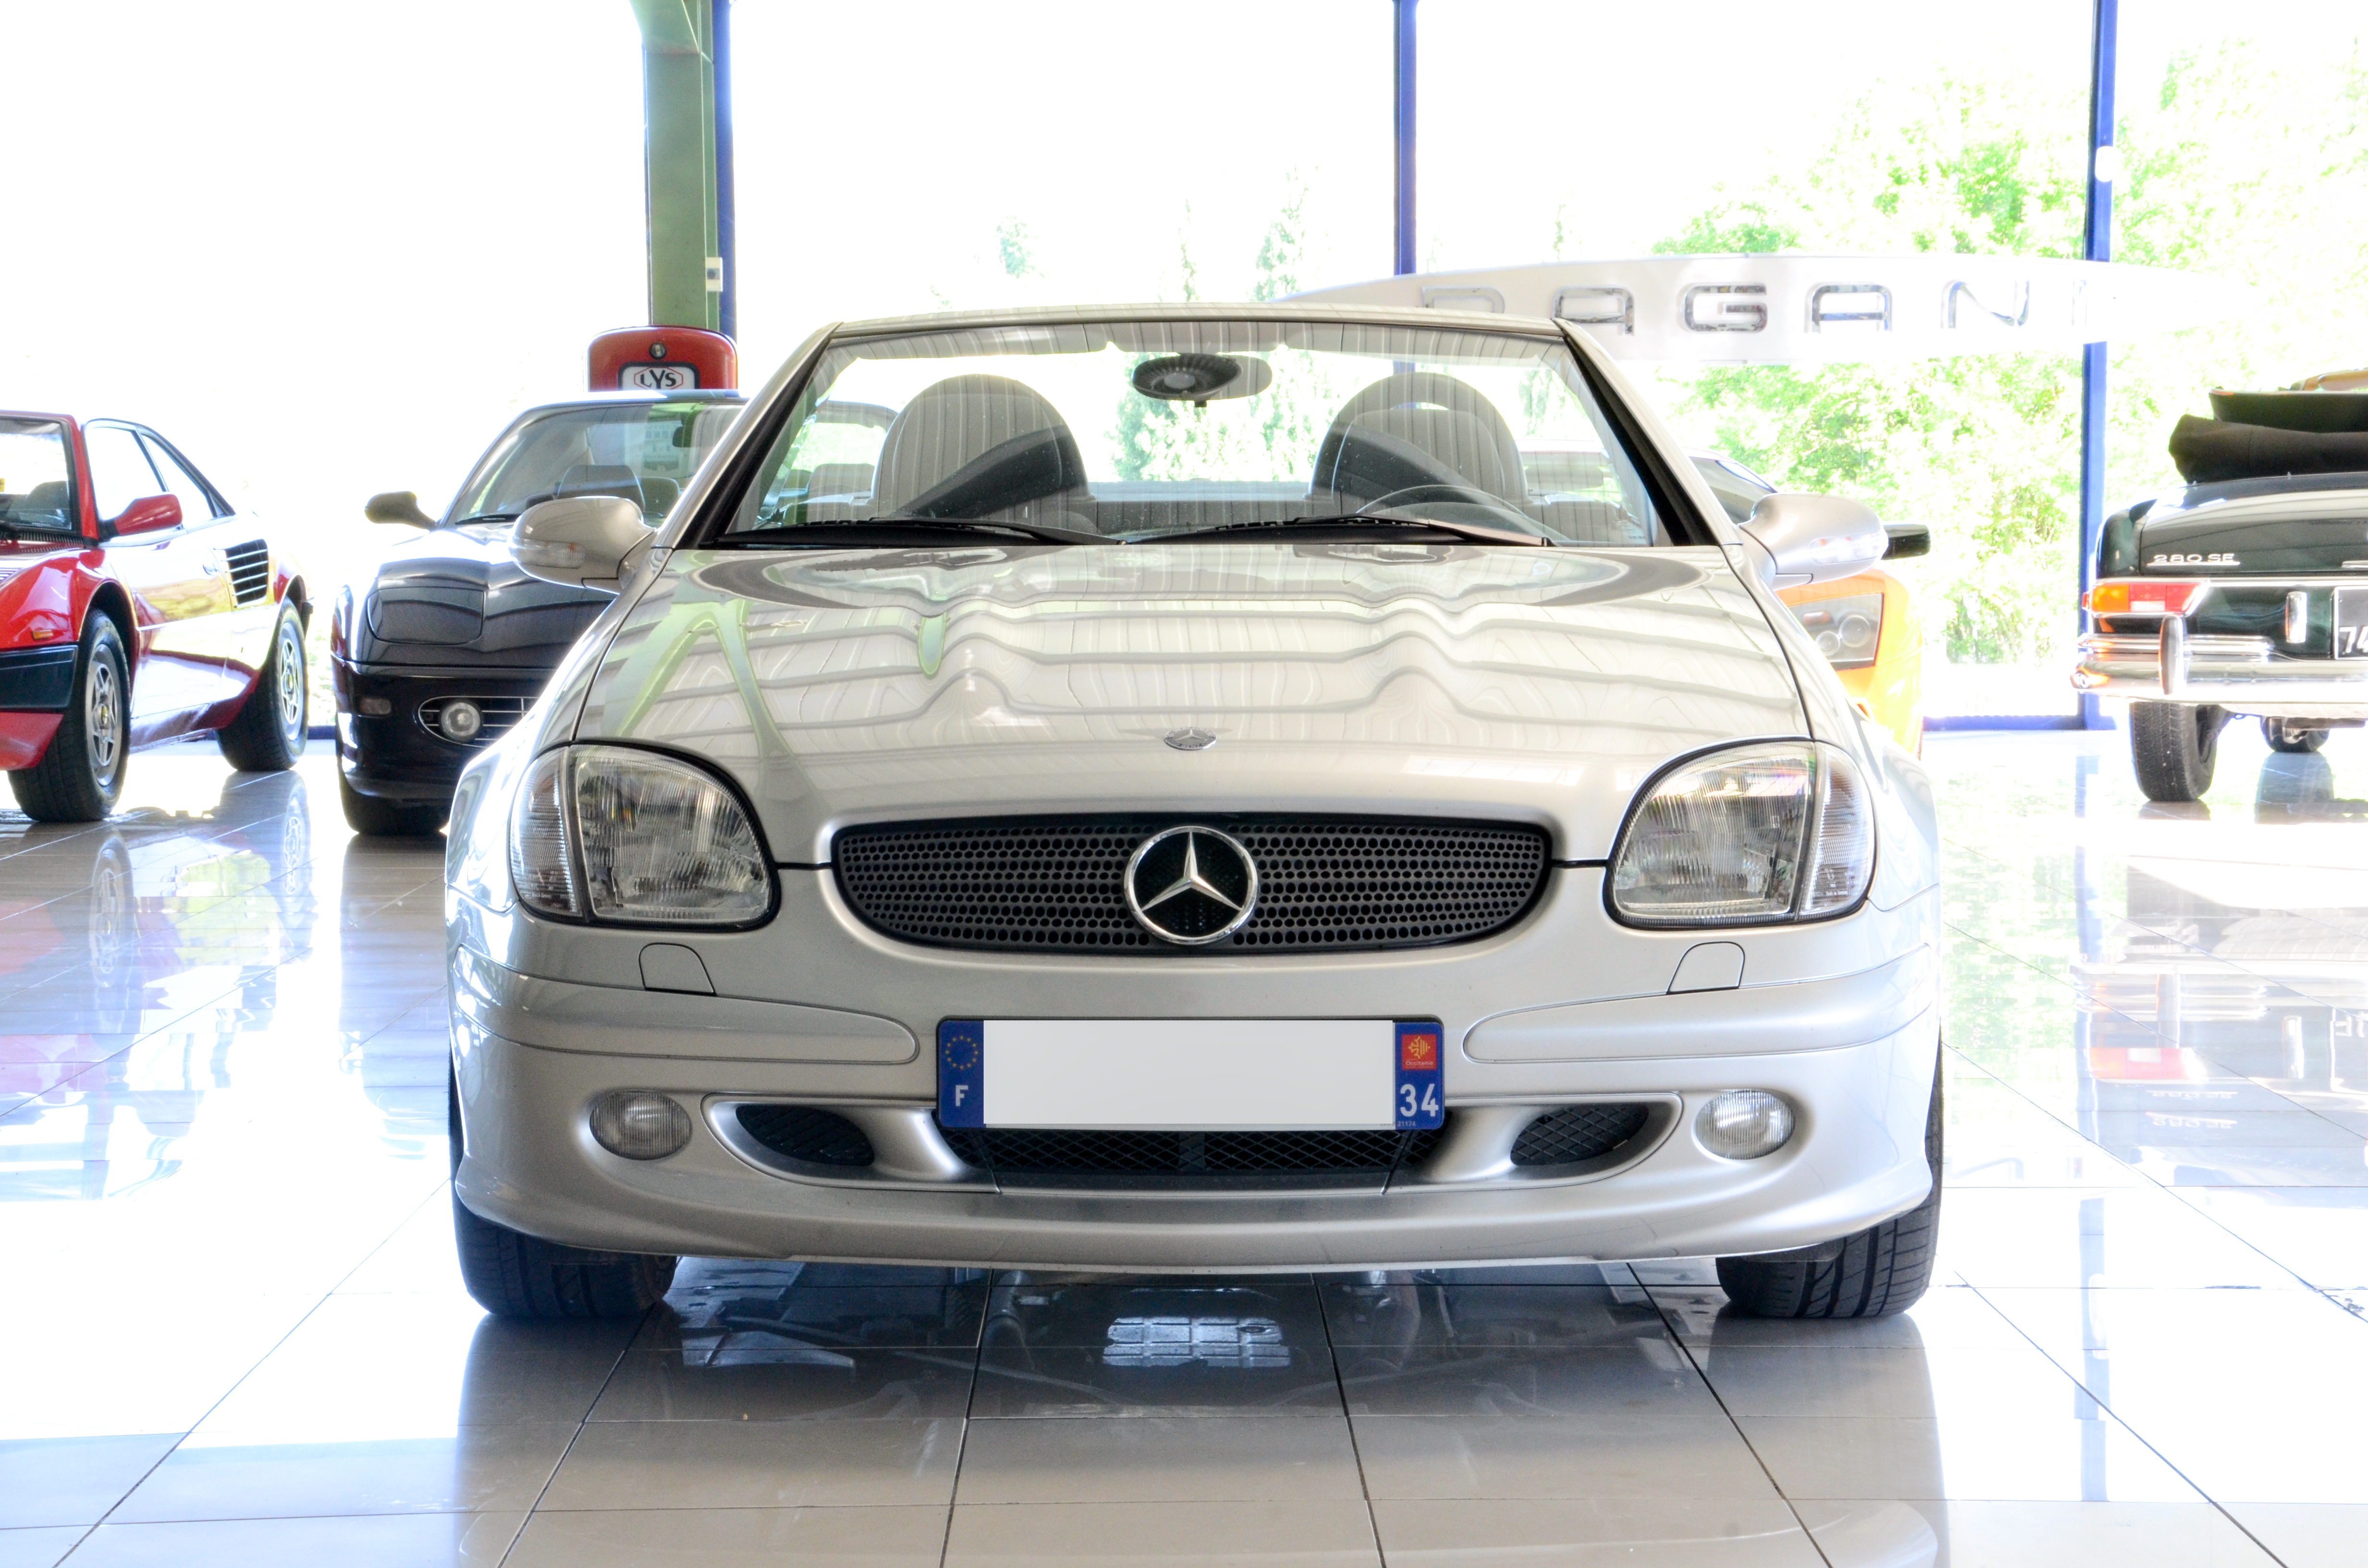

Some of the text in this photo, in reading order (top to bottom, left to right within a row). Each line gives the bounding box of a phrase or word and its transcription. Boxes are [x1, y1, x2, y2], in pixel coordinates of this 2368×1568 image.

[640, 369, 677, 390] LYS
[2153, 553, 2234, 563] 280 SE
[955, 1085, 969, 1107] F
[1400, 1083, 1439, 1117] 34
